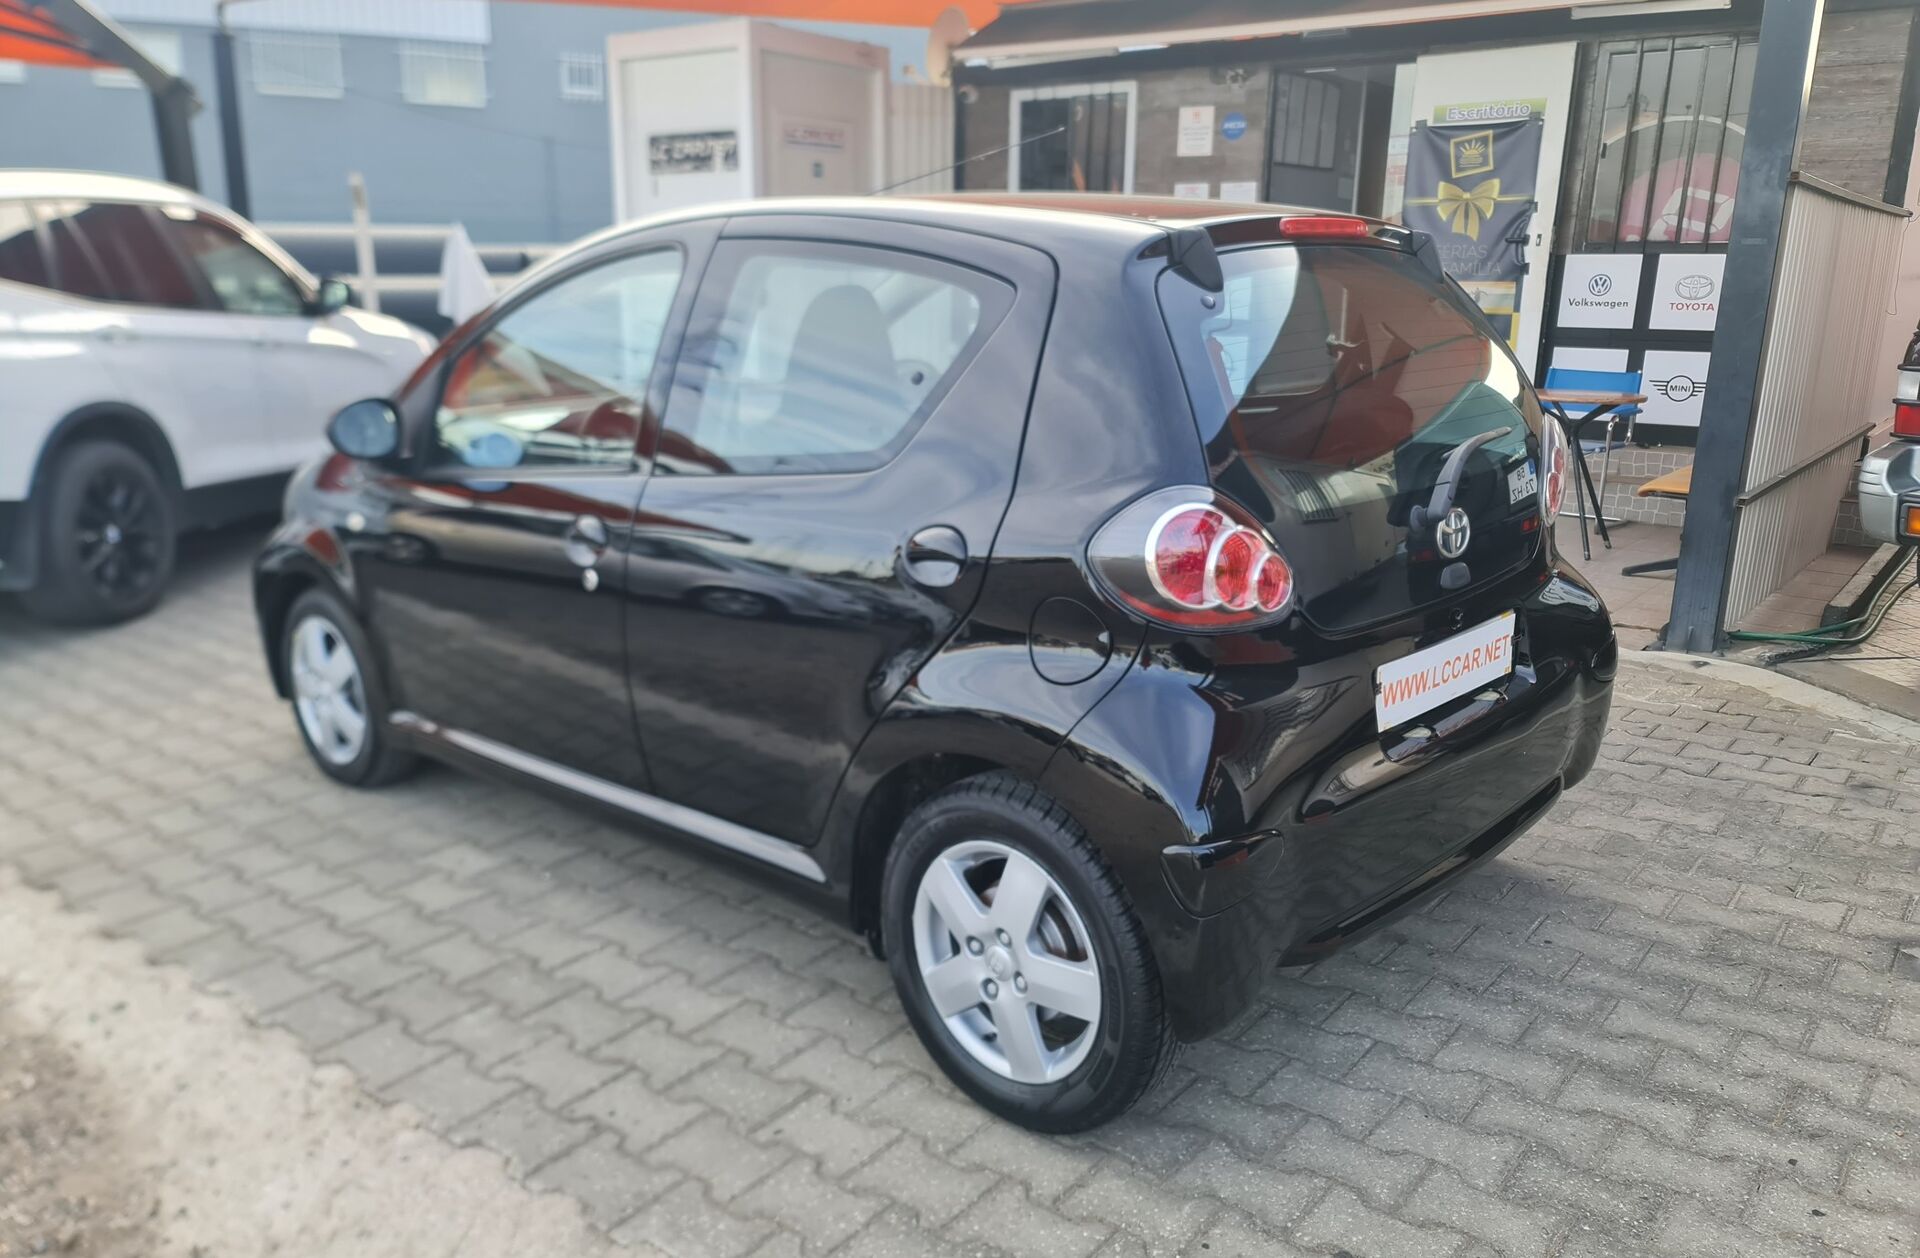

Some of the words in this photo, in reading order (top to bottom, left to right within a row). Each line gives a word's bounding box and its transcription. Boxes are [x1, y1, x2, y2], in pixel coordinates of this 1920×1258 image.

[1446, 103, 1530, 121] Escritório
[1568, 298, 1629, 310] Volkswagen
[1670, 303, 1714, 312] TOYOTA
[1669, 384, 1691, 393] MINI
[1382, 634, 1510, 708] WWW.LCCAR.NET
